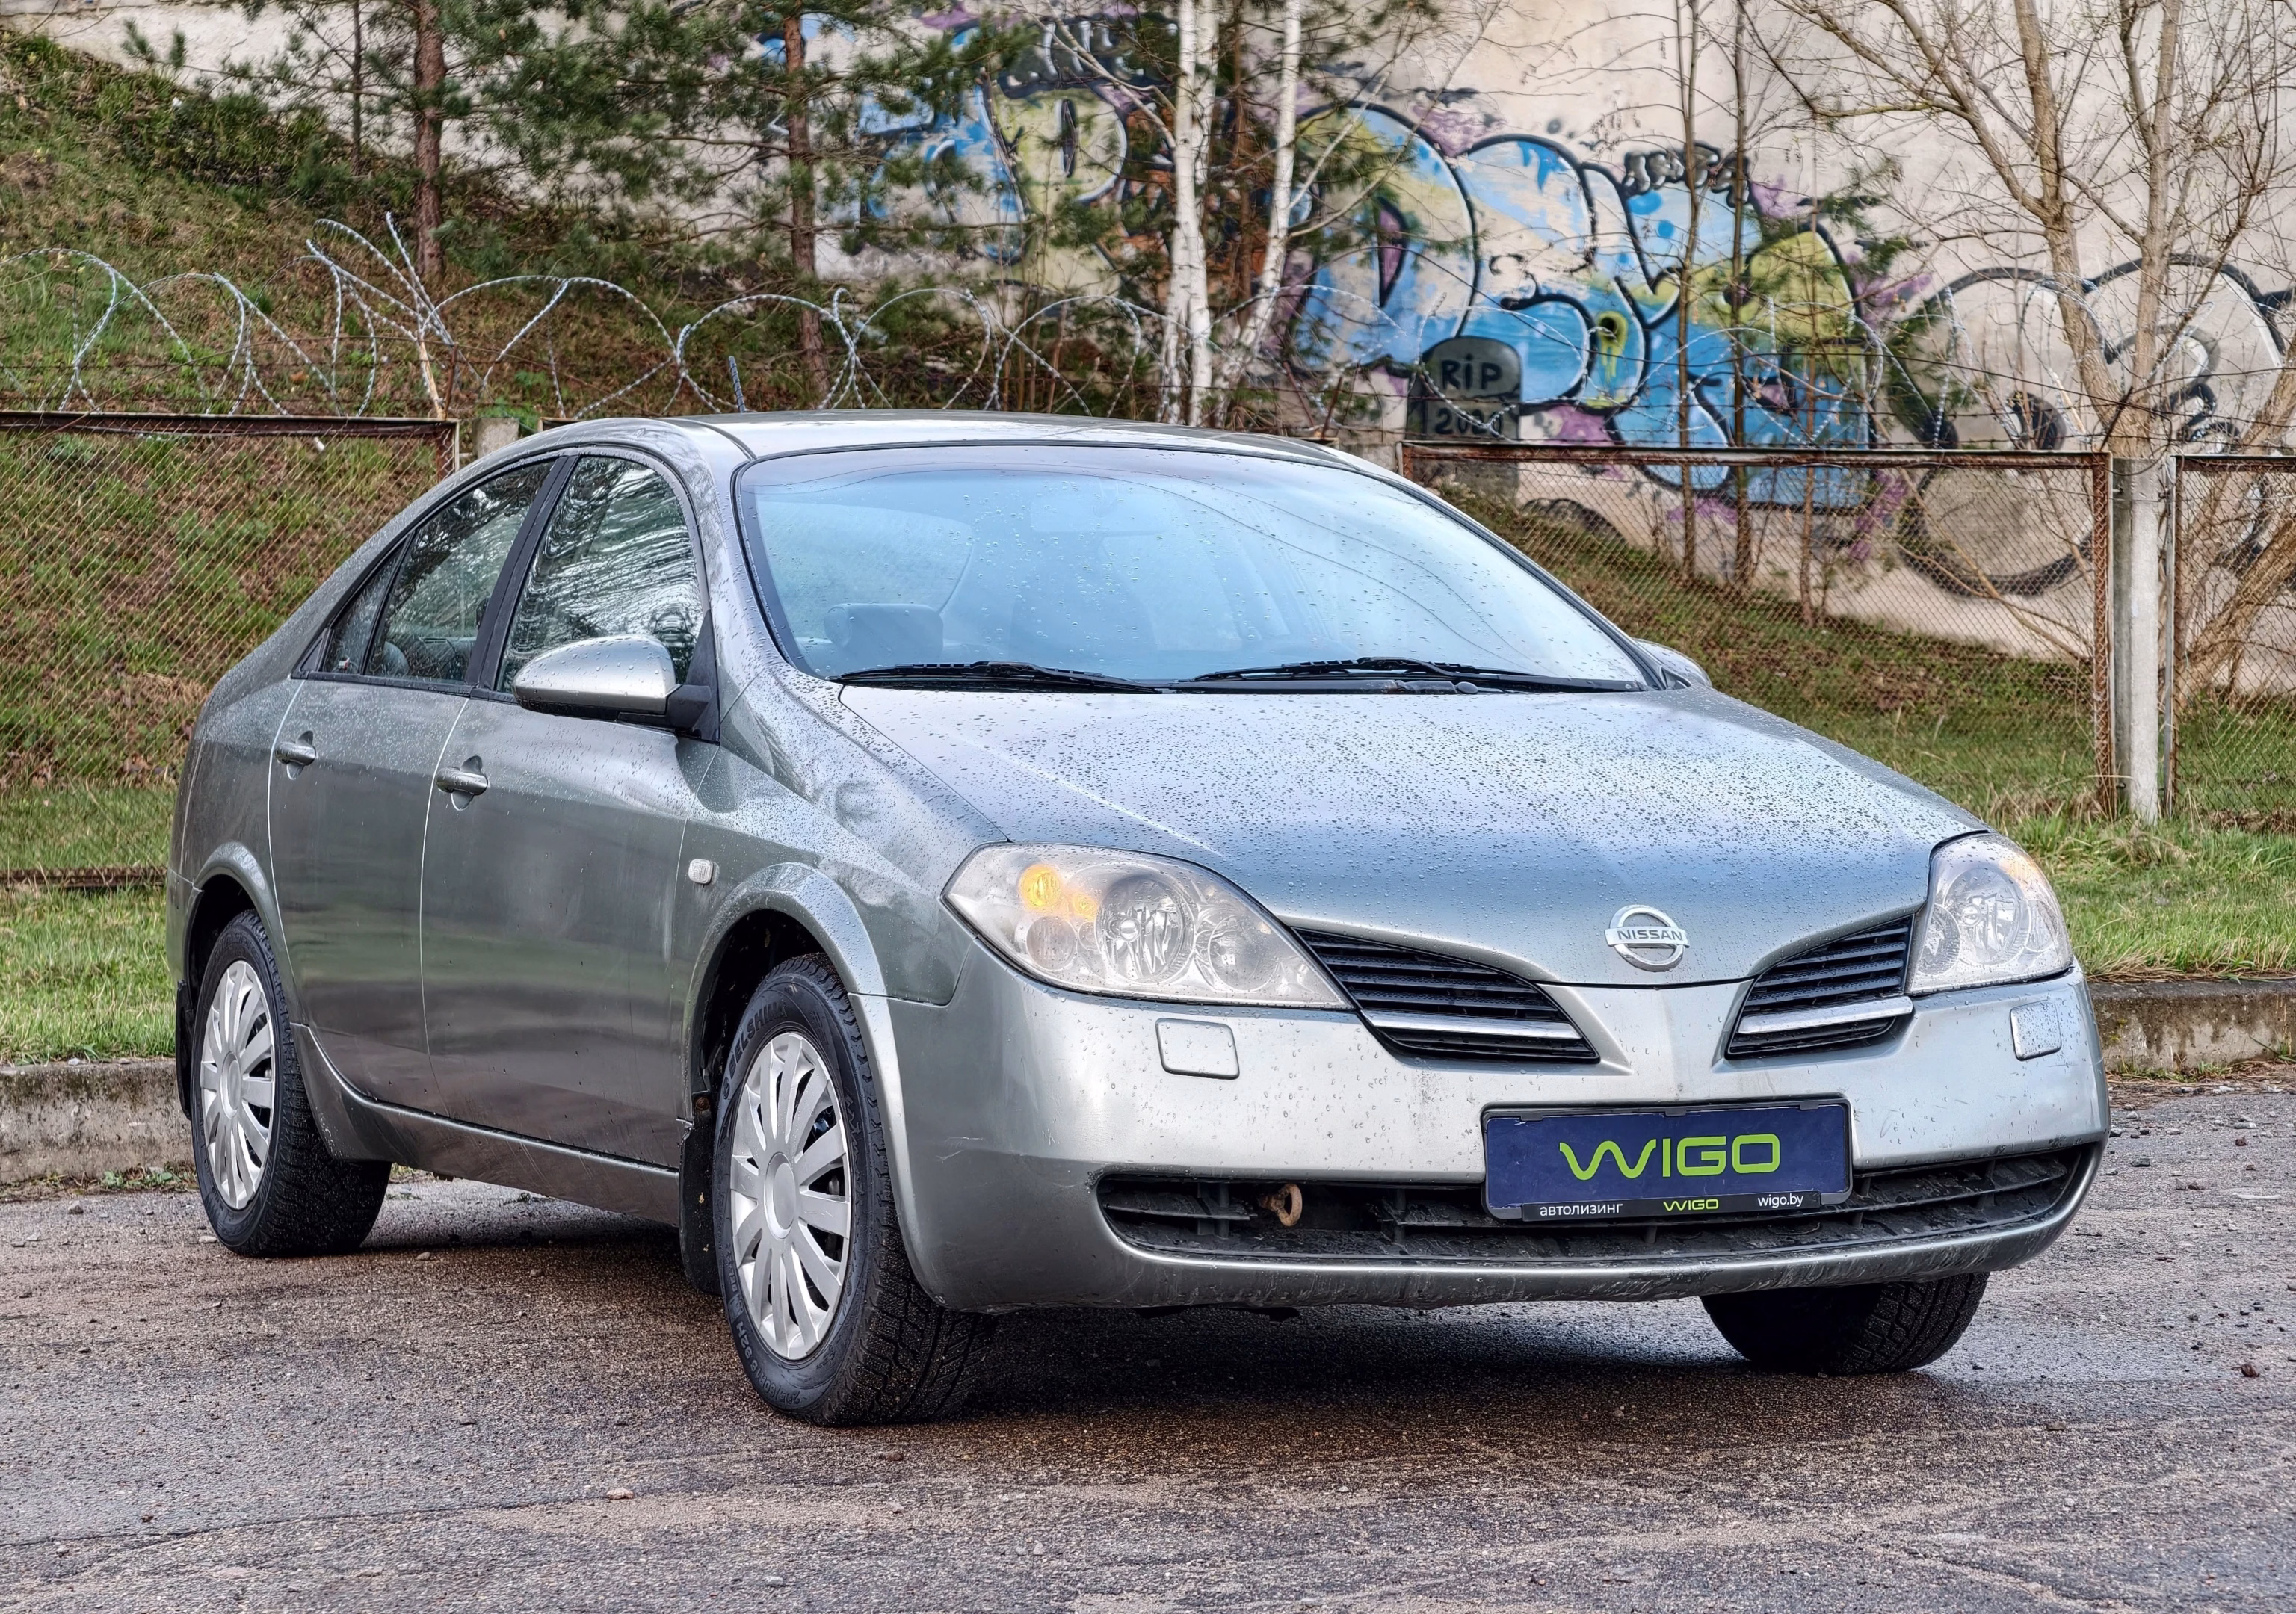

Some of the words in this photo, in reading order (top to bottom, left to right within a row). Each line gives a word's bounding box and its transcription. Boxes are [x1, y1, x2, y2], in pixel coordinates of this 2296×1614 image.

[1617, 930, 1682, 941] NISSAN
[1559, 1133, 1781, 1181] WIGO
[1662, 1199, 1720, 1212] WIGO
[1757, 1193, 1804, 1208] wigo.by
[1539, 1202, 1623, 1217] автолизинг
